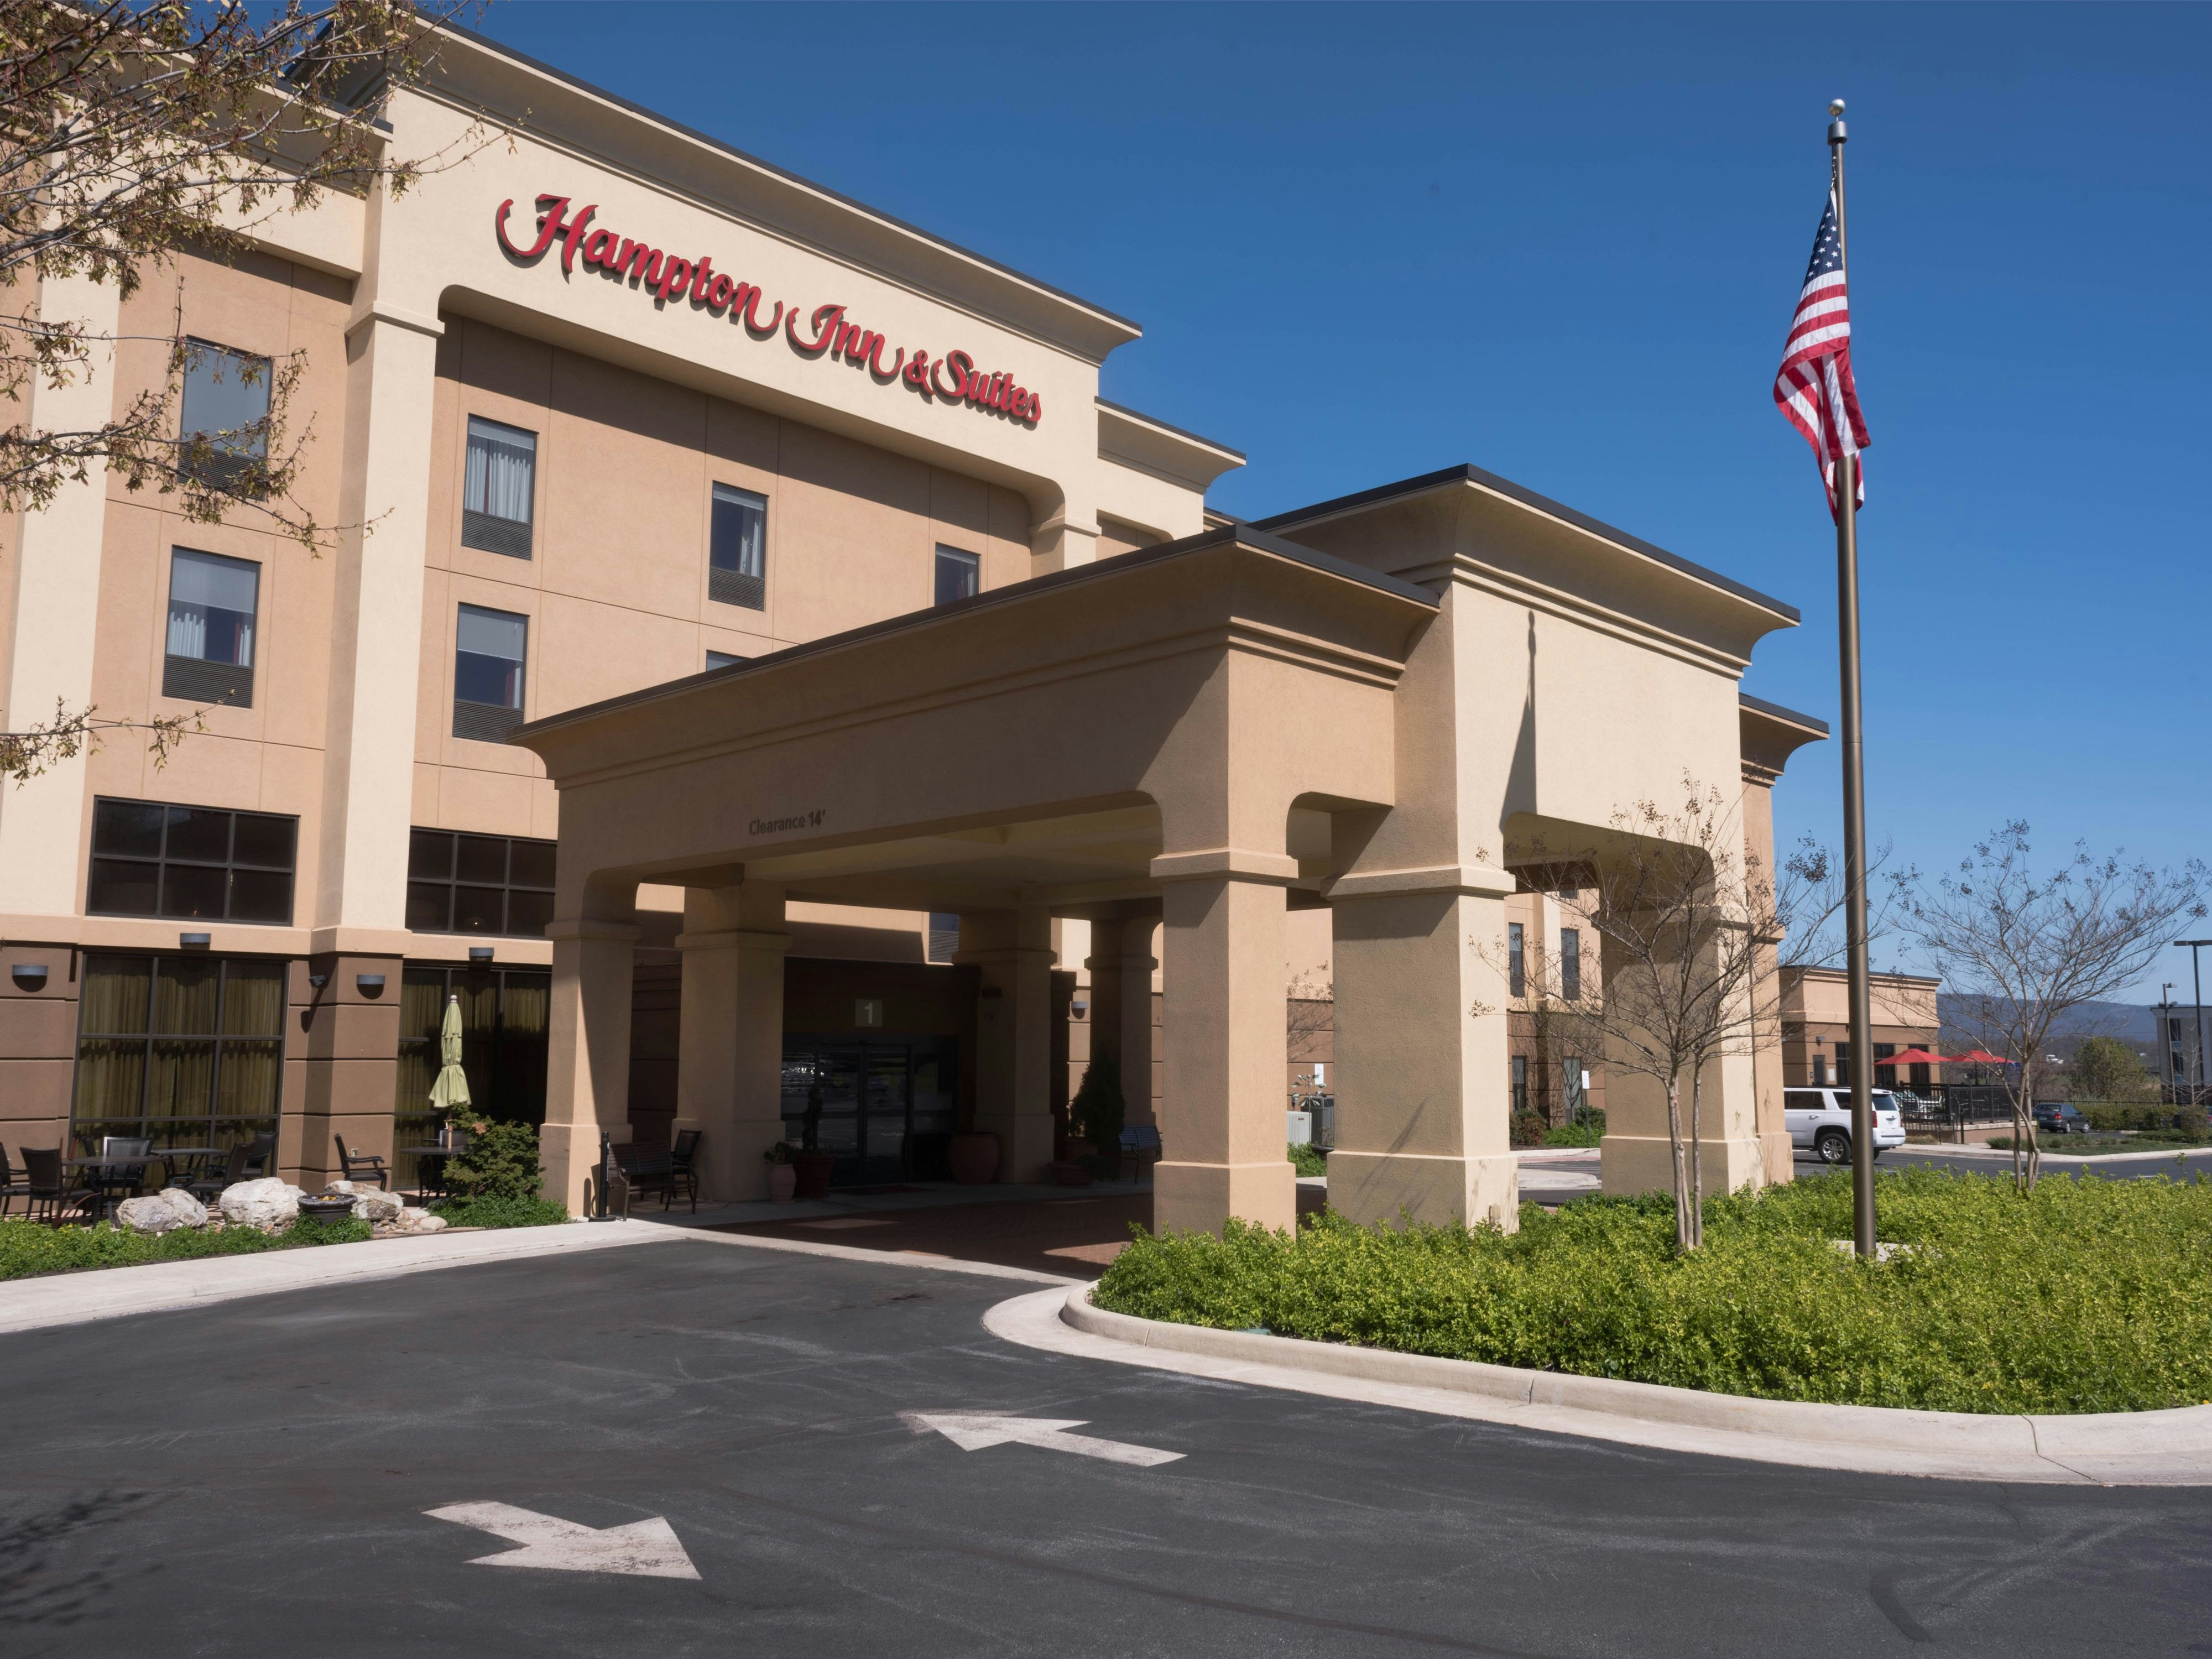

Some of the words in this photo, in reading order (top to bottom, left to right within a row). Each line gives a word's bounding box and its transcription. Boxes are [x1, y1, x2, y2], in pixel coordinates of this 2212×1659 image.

[498, 193, 784, 332] Hampton
[788, 304, 905, 377] Inn
[905, 349, 936, 395] &
[934, 349, 1042, 423] Suites
[749, 815, 805, 835] Clearance
[864, 1003, 873, 1024] 1
